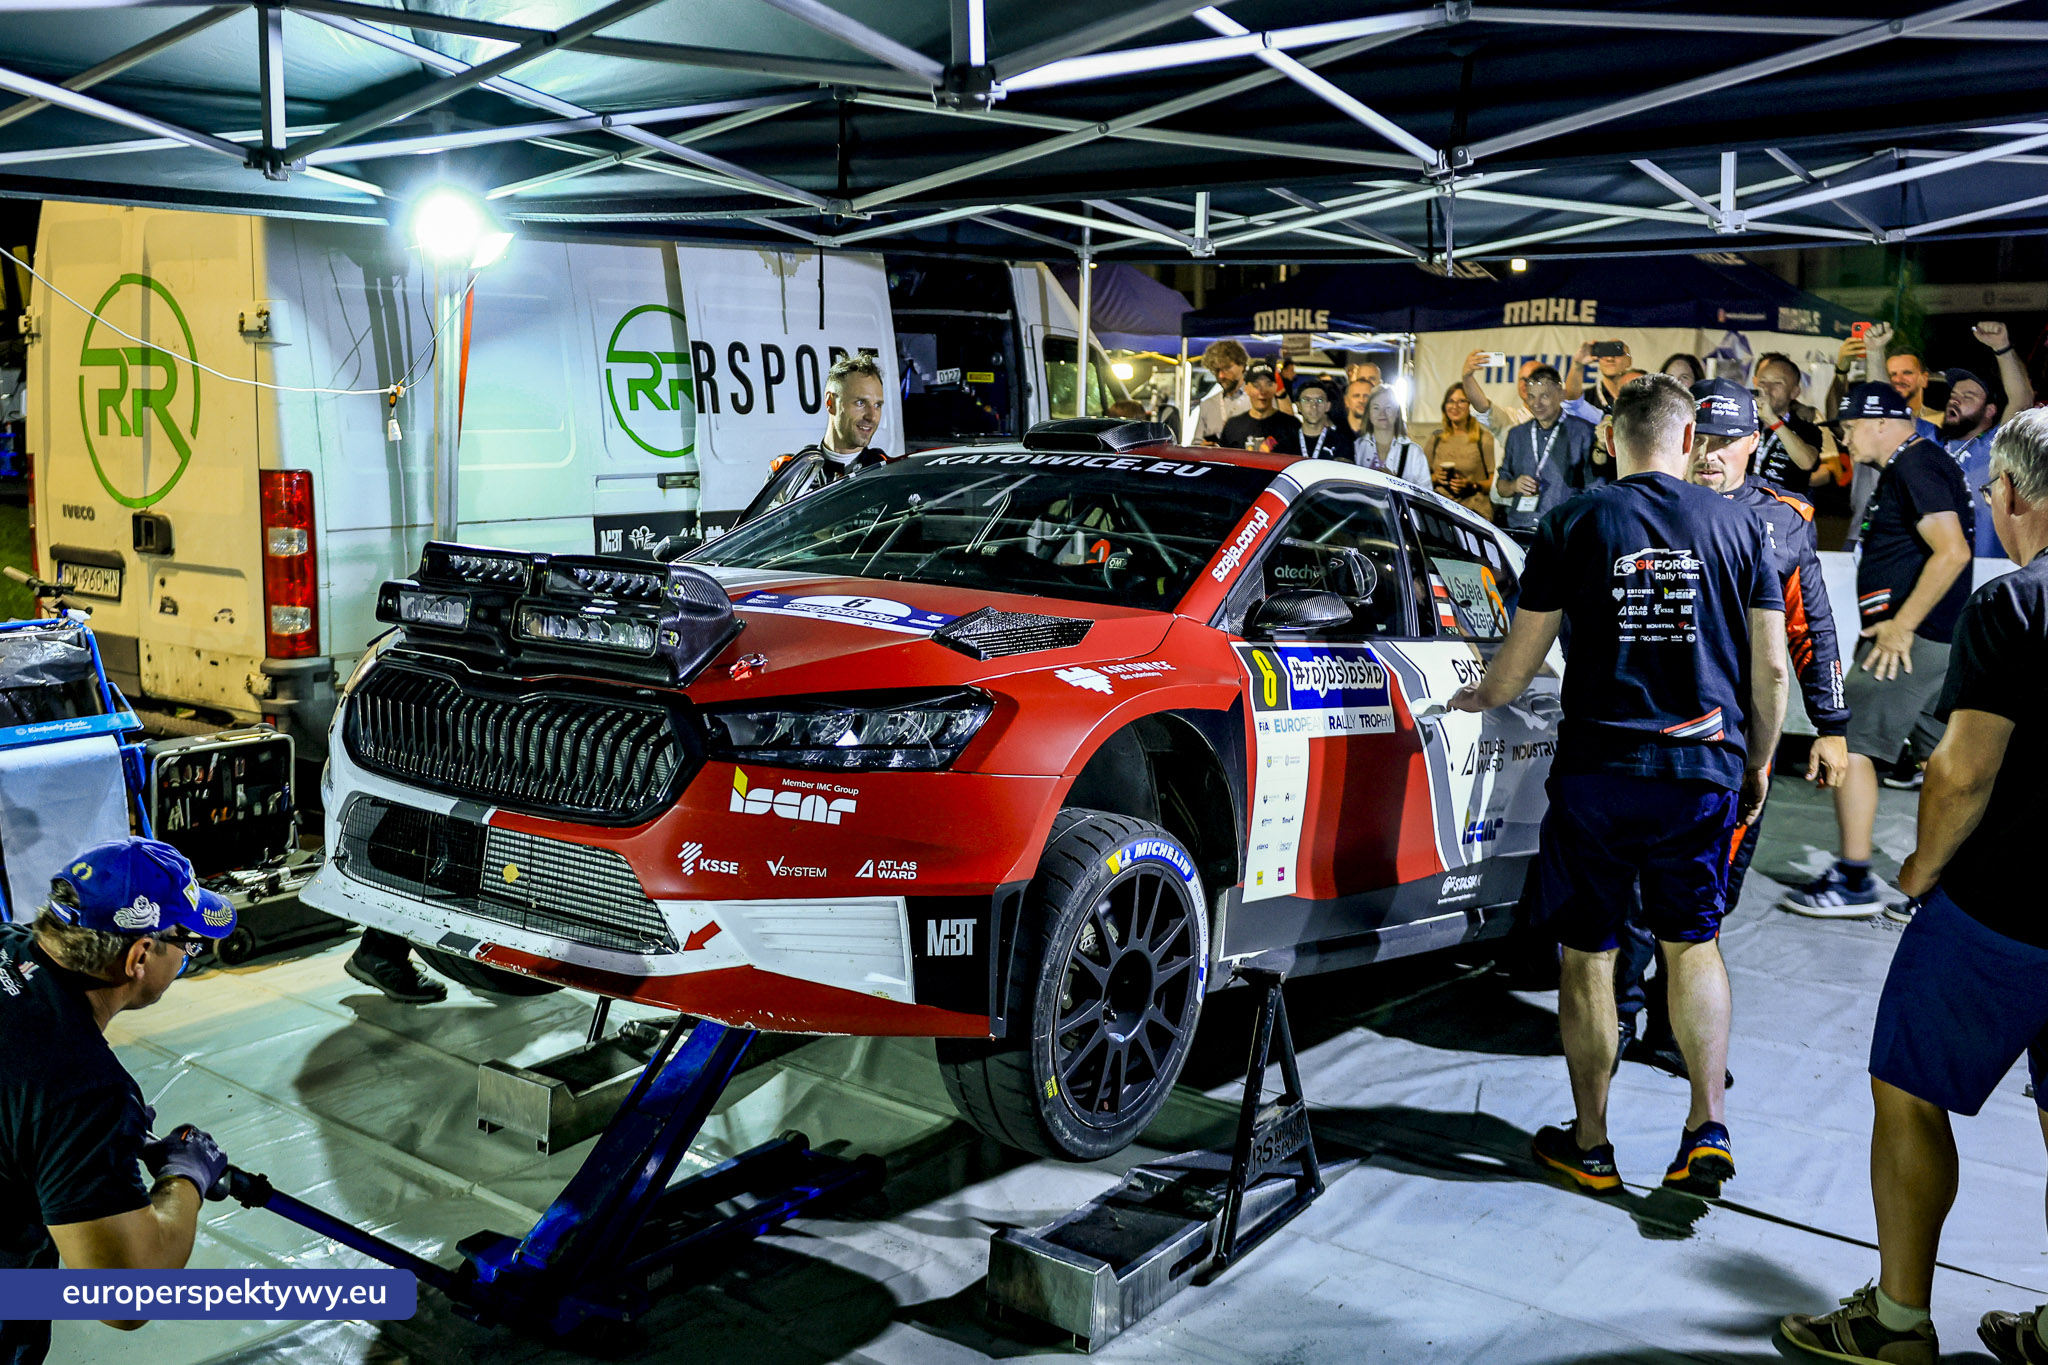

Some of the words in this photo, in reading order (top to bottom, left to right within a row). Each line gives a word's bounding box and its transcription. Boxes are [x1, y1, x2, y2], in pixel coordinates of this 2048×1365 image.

[1253, 308, 1330, 332] MAHLE
[1503, 297, 1598, 325] MAHLE
[925, 454, 1211, 477] KATOWICE.EU
[62, 503, 96, 521] IVECO
[600, 529, 623, 553] MBT
[1211, 506, 1270, 583] szeja.com.pl
[1109, 558, 1127, 568] OMP
[1636, 560, 1700, 570] GKFORGE
[1656, 573, 1676, 581] Rally
[1677, 572, 1700, 580] Team
[842, 598, 872, 608] 6
[1481, 566, 1509, 637] 6
[1098, 661, 1177, 674] KATOWICE
[1252, 649, 1278, 707] 6
[1289, 657, 1384, 697] #rajdslaska
[1328, 714, 1356, 730] RALLY
[1359, 713, 1392, 729] TROPHY
[1478, 739, 1506, 756] ATLAS
[1477, 757, 1504, 774] WARD
[782, 778, 815, 789] Member
[816, 782, 832, 792] IMC
[834, 785, 859, 796] Group
[700, 858, 739, 875] KSSE
[877, 860, 917, 871] ATLAS
[1134, 841, 1191, 876] MICHELIN
[877, 870, 917, 880] WARD
[927, 919, 977, 956] MBT
[1252, 1136, 1274, 1174] RS
